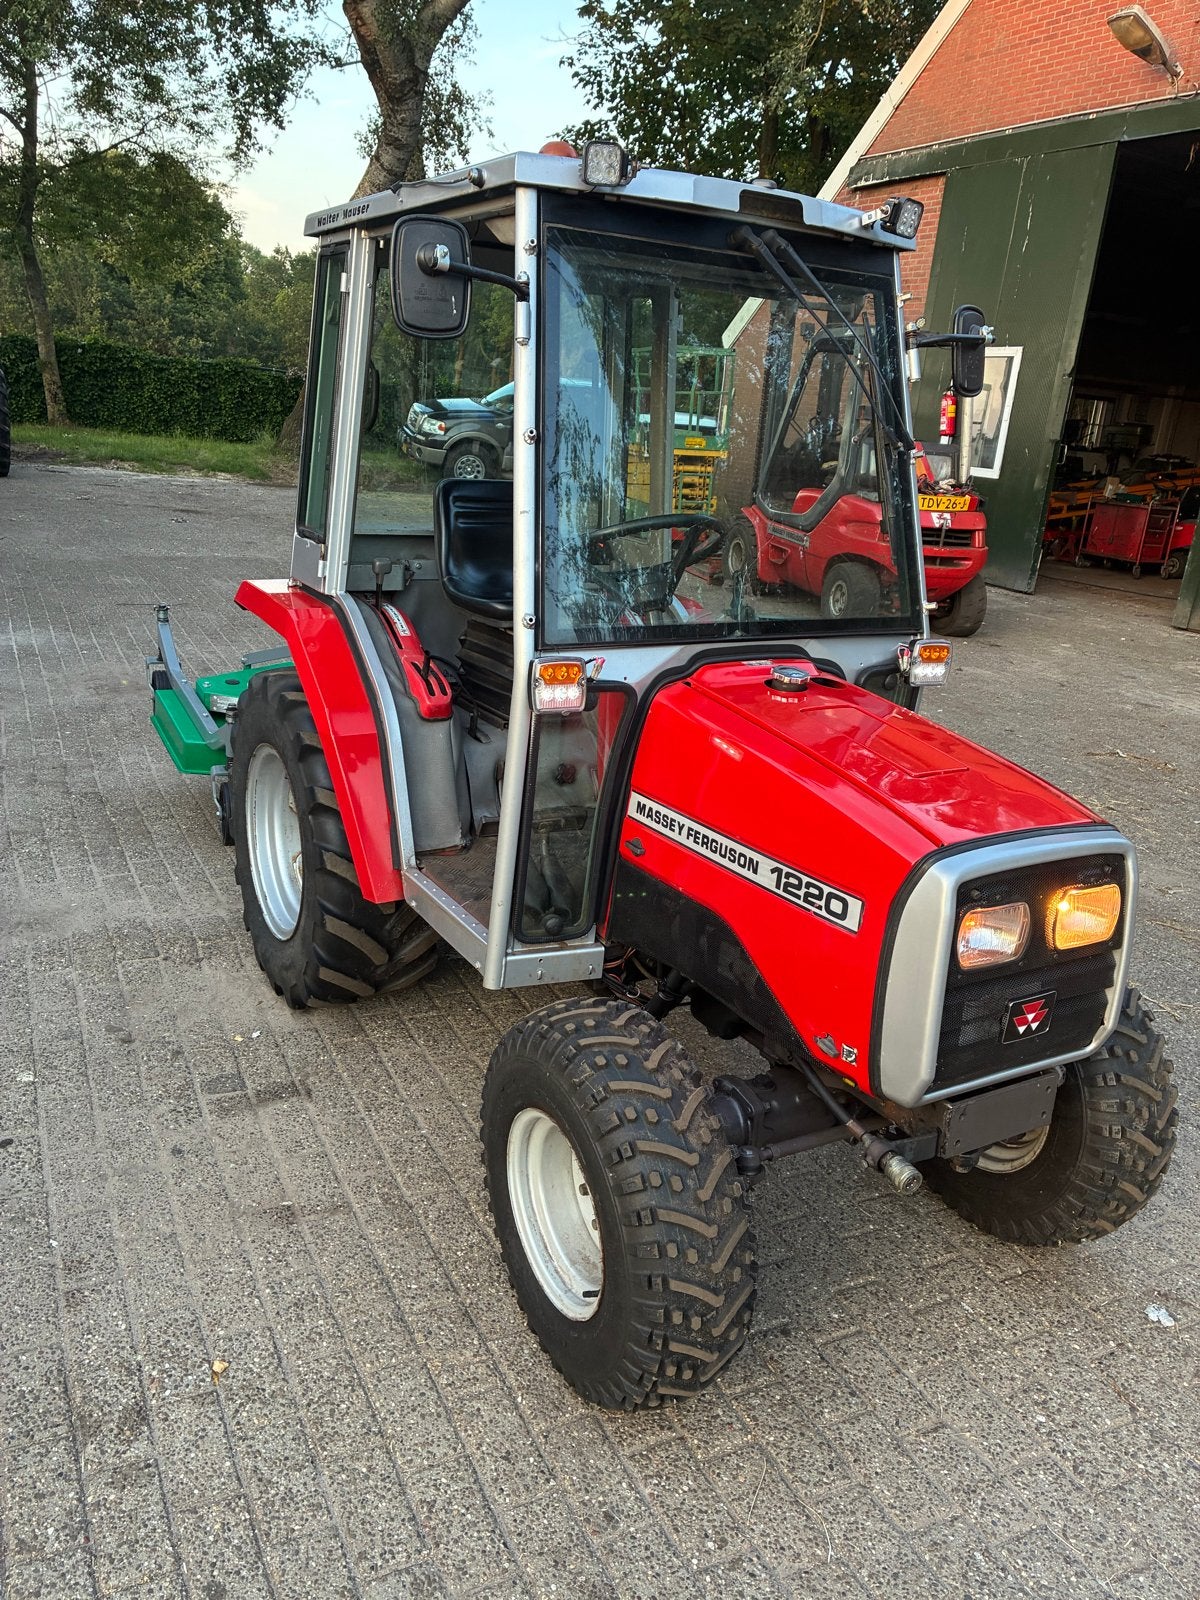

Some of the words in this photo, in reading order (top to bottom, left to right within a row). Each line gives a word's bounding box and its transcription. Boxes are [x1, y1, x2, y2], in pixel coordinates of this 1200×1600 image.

[317, 212, 340, 227] Walter
[342, 203, 370, 220] Mauser
[636, 800, 686, 837] MASSEY
[686, 826, 759, 876] FERGUSON
[770, 866, 849, 922] 1220
